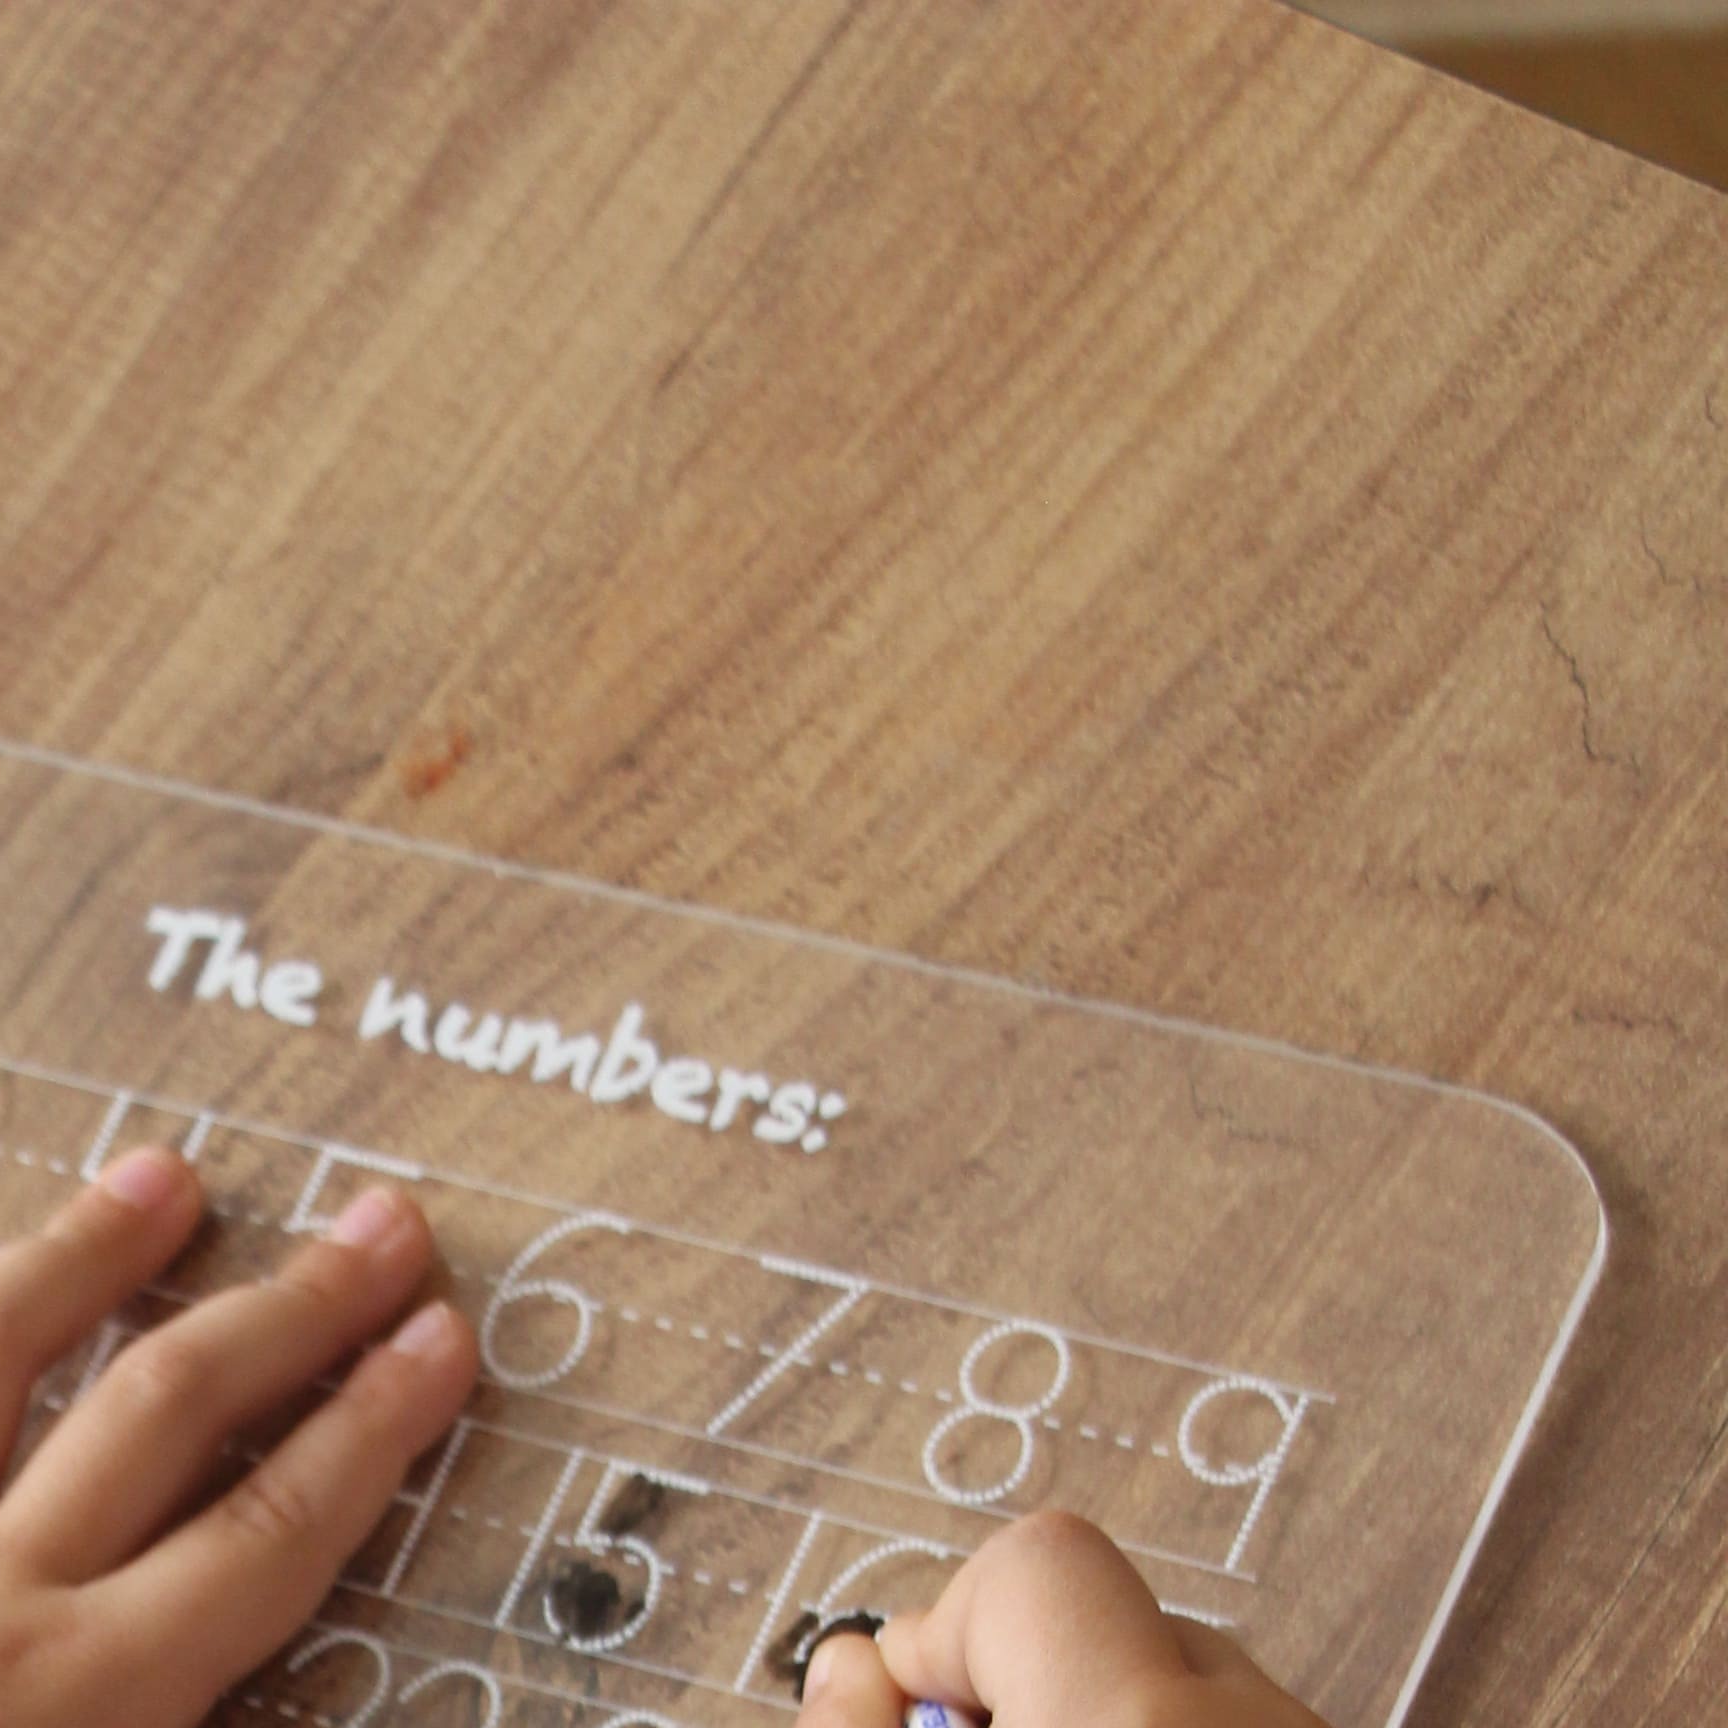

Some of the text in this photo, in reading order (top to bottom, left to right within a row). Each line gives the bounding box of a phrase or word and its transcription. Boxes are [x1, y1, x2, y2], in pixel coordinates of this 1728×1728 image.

[146, 904, 322, 1027] The
[359, 976, 847, 1153] numbers:
[479, 1210, 632, 1389] 6
[704, 1254, 875, 1440] 7
[921, 1317, 1072, 1505] 8
[1177, 1373, 1310, 1571] 9
[493, 1449, 711, 1652] 15
